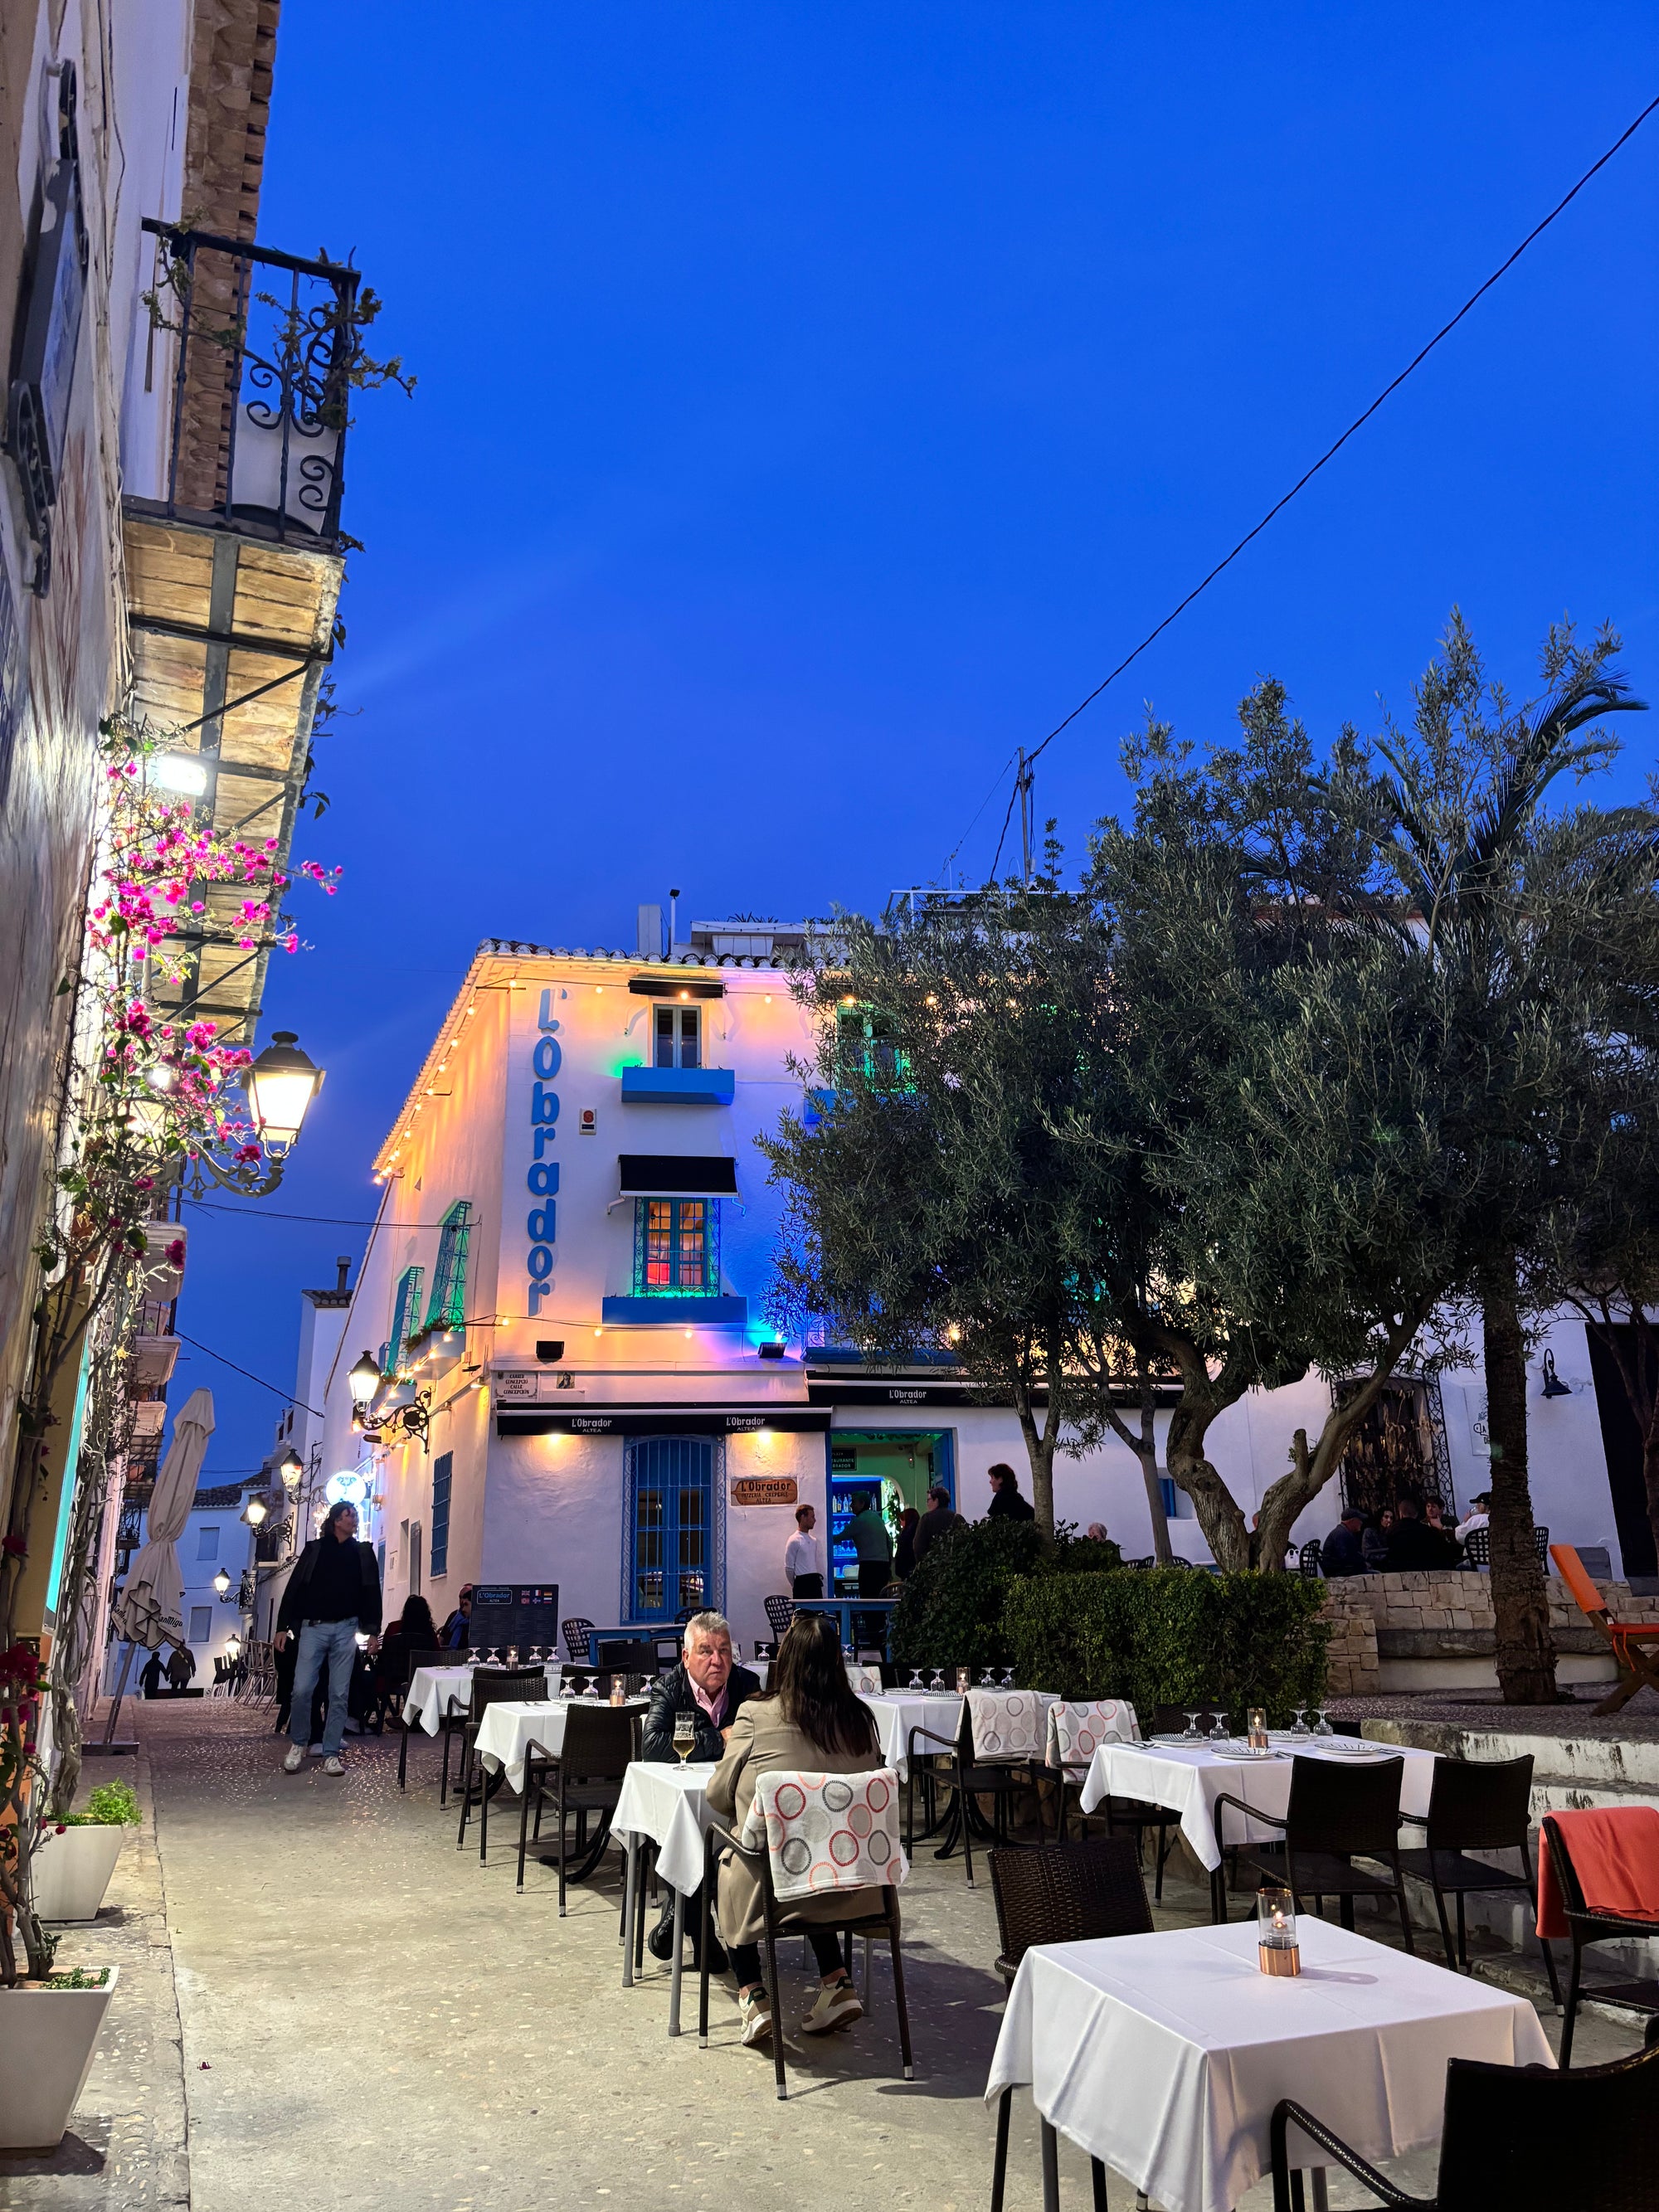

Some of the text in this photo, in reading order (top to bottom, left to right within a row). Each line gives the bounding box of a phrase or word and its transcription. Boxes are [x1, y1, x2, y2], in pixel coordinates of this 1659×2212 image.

[527, 988, 568, 1317] L'Obrador
[888, 1389, 927, 1399] L'Obrador
[572, 1417, 612, 1427] L'Obrador
[726, 1417, 766, 1427] L'Obrador
[741, 1480, 791, 1492] L'Obrador
